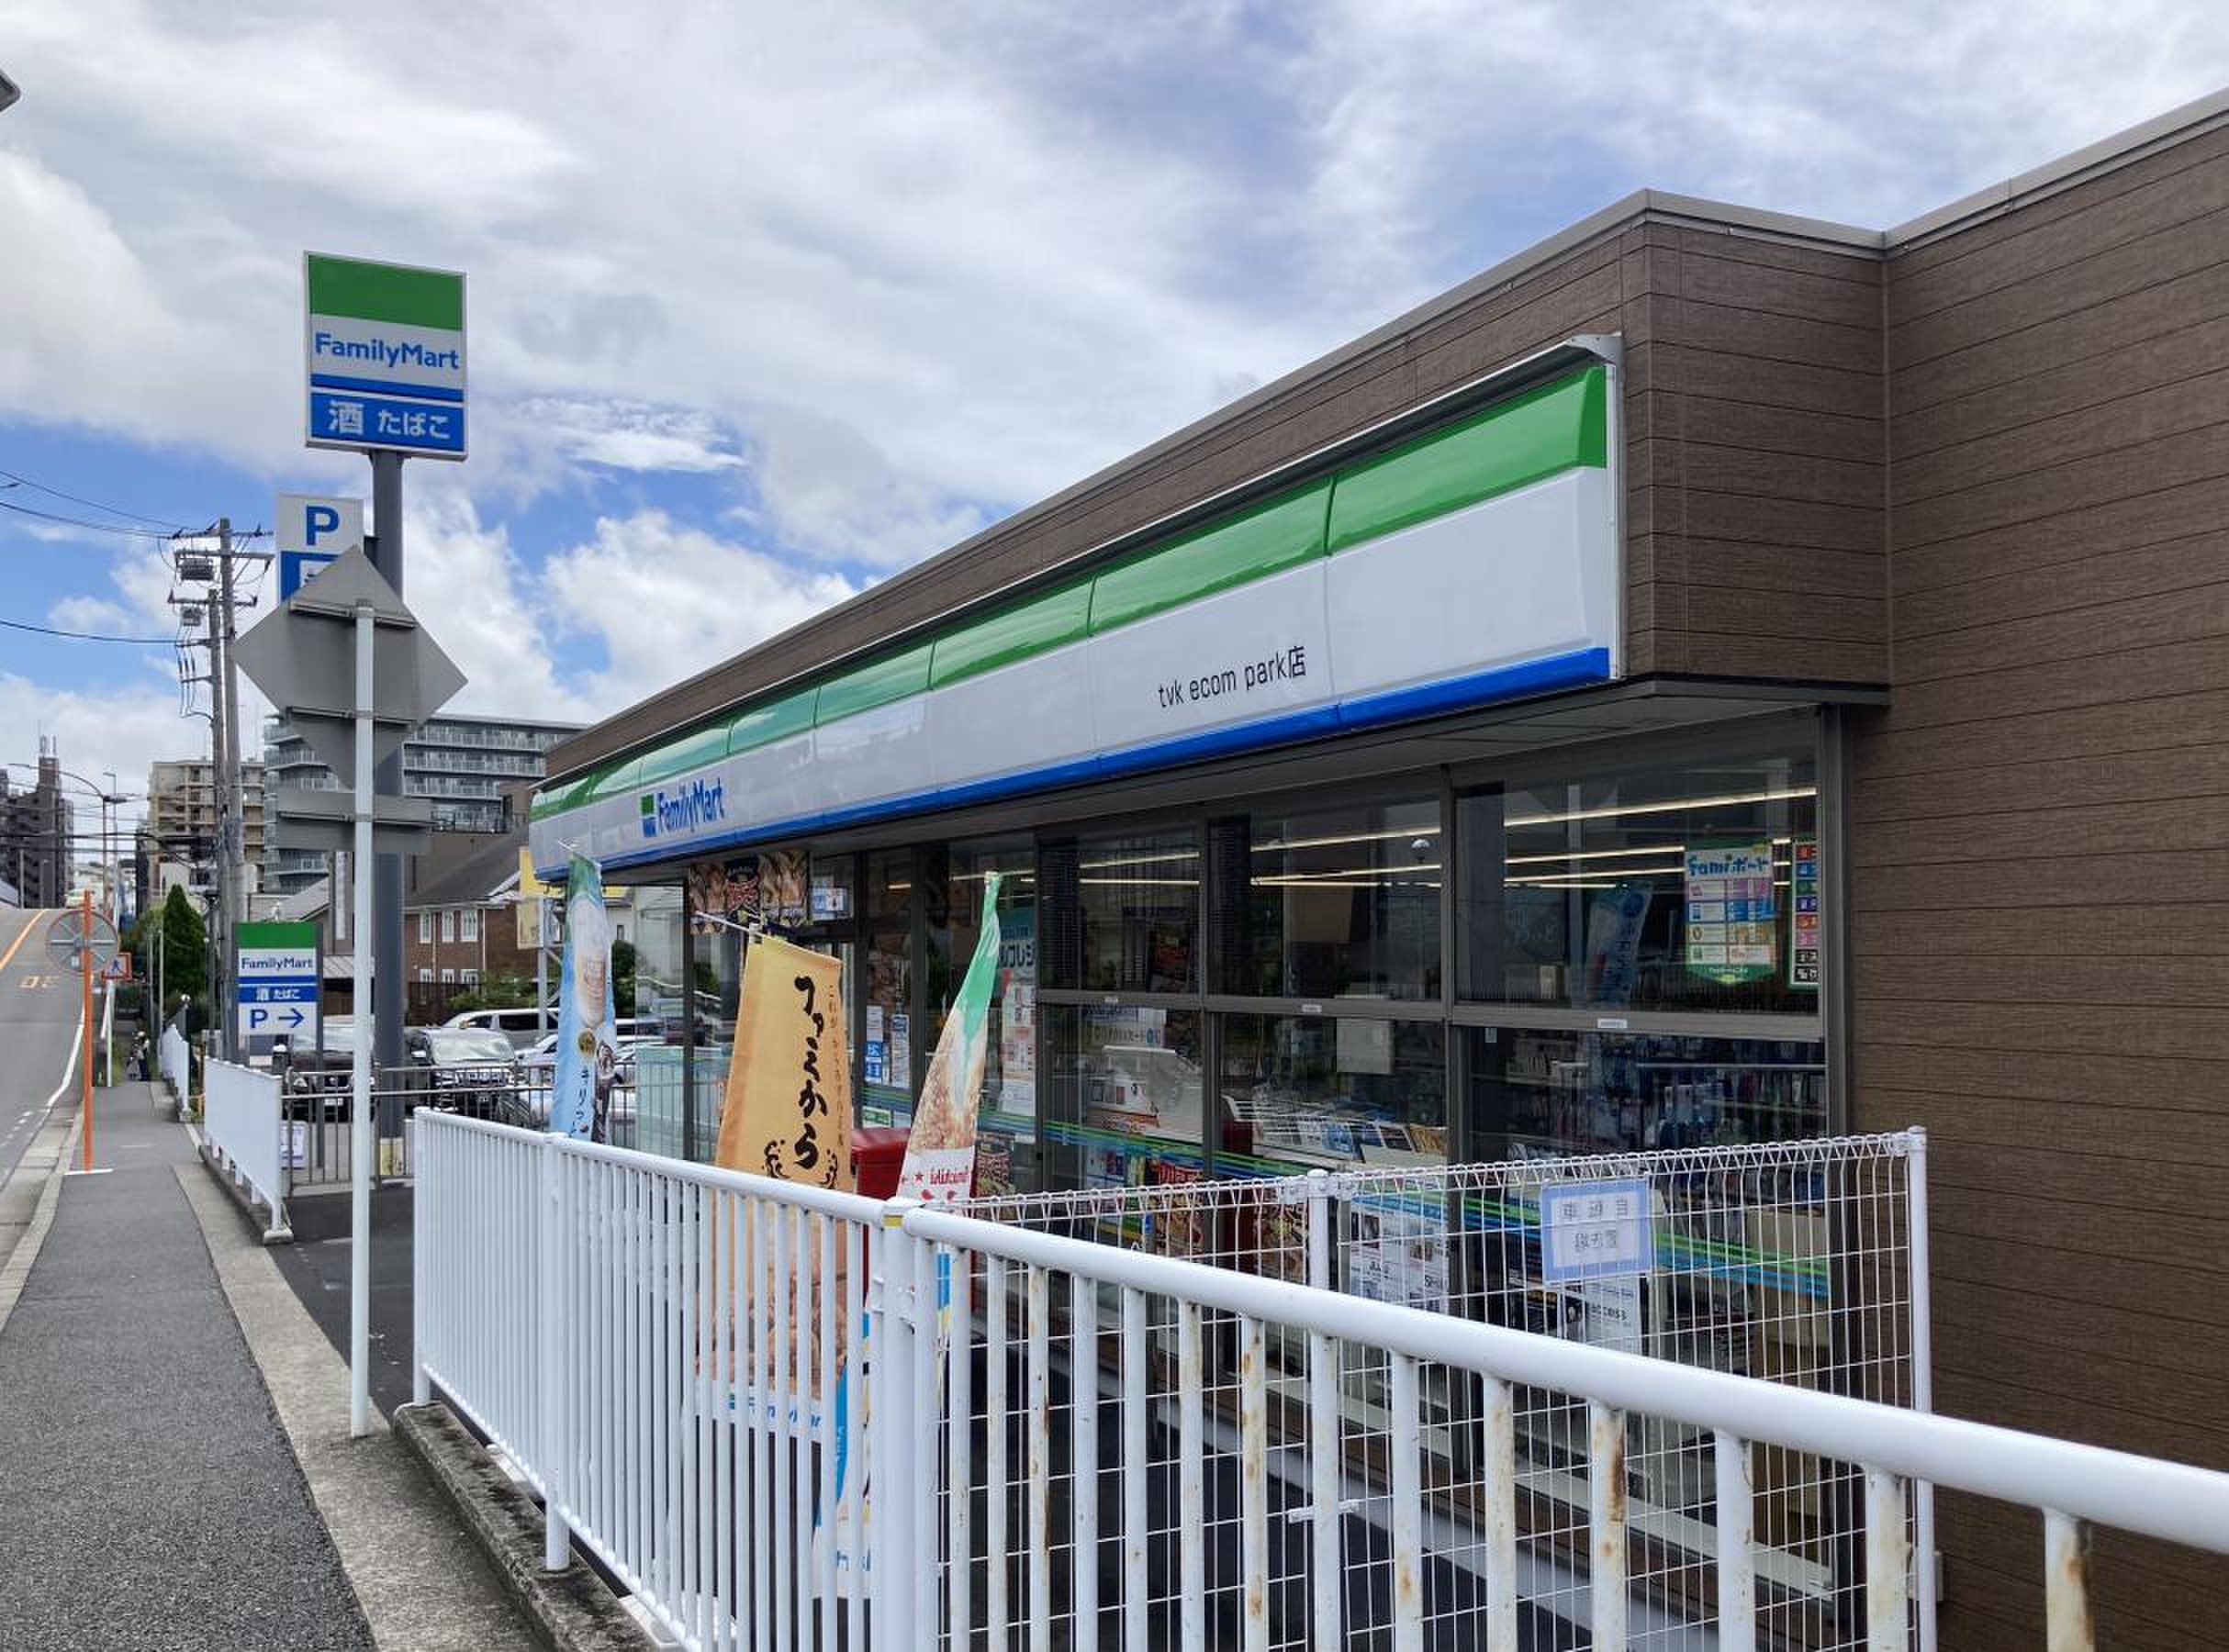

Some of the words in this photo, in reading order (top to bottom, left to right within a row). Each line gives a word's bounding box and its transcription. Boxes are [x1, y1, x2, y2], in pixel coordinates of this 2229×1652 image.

[315, 332, 460, 370] FamilyMart
[329, 399, 364, 436] 酒
[377, 408, 451, 440] たばこ
[306, 504, 340, 547] P
[1158, 679, 1184, 708] tvk
[1189, 670, 1237, 700] ecom
[1244, 645, 1306, 691] park店
[658, 776, 724, 833] FamilyMart
[241, 957, 313, 971] FamilyMart
[250, 1009, 268, 1029] P
